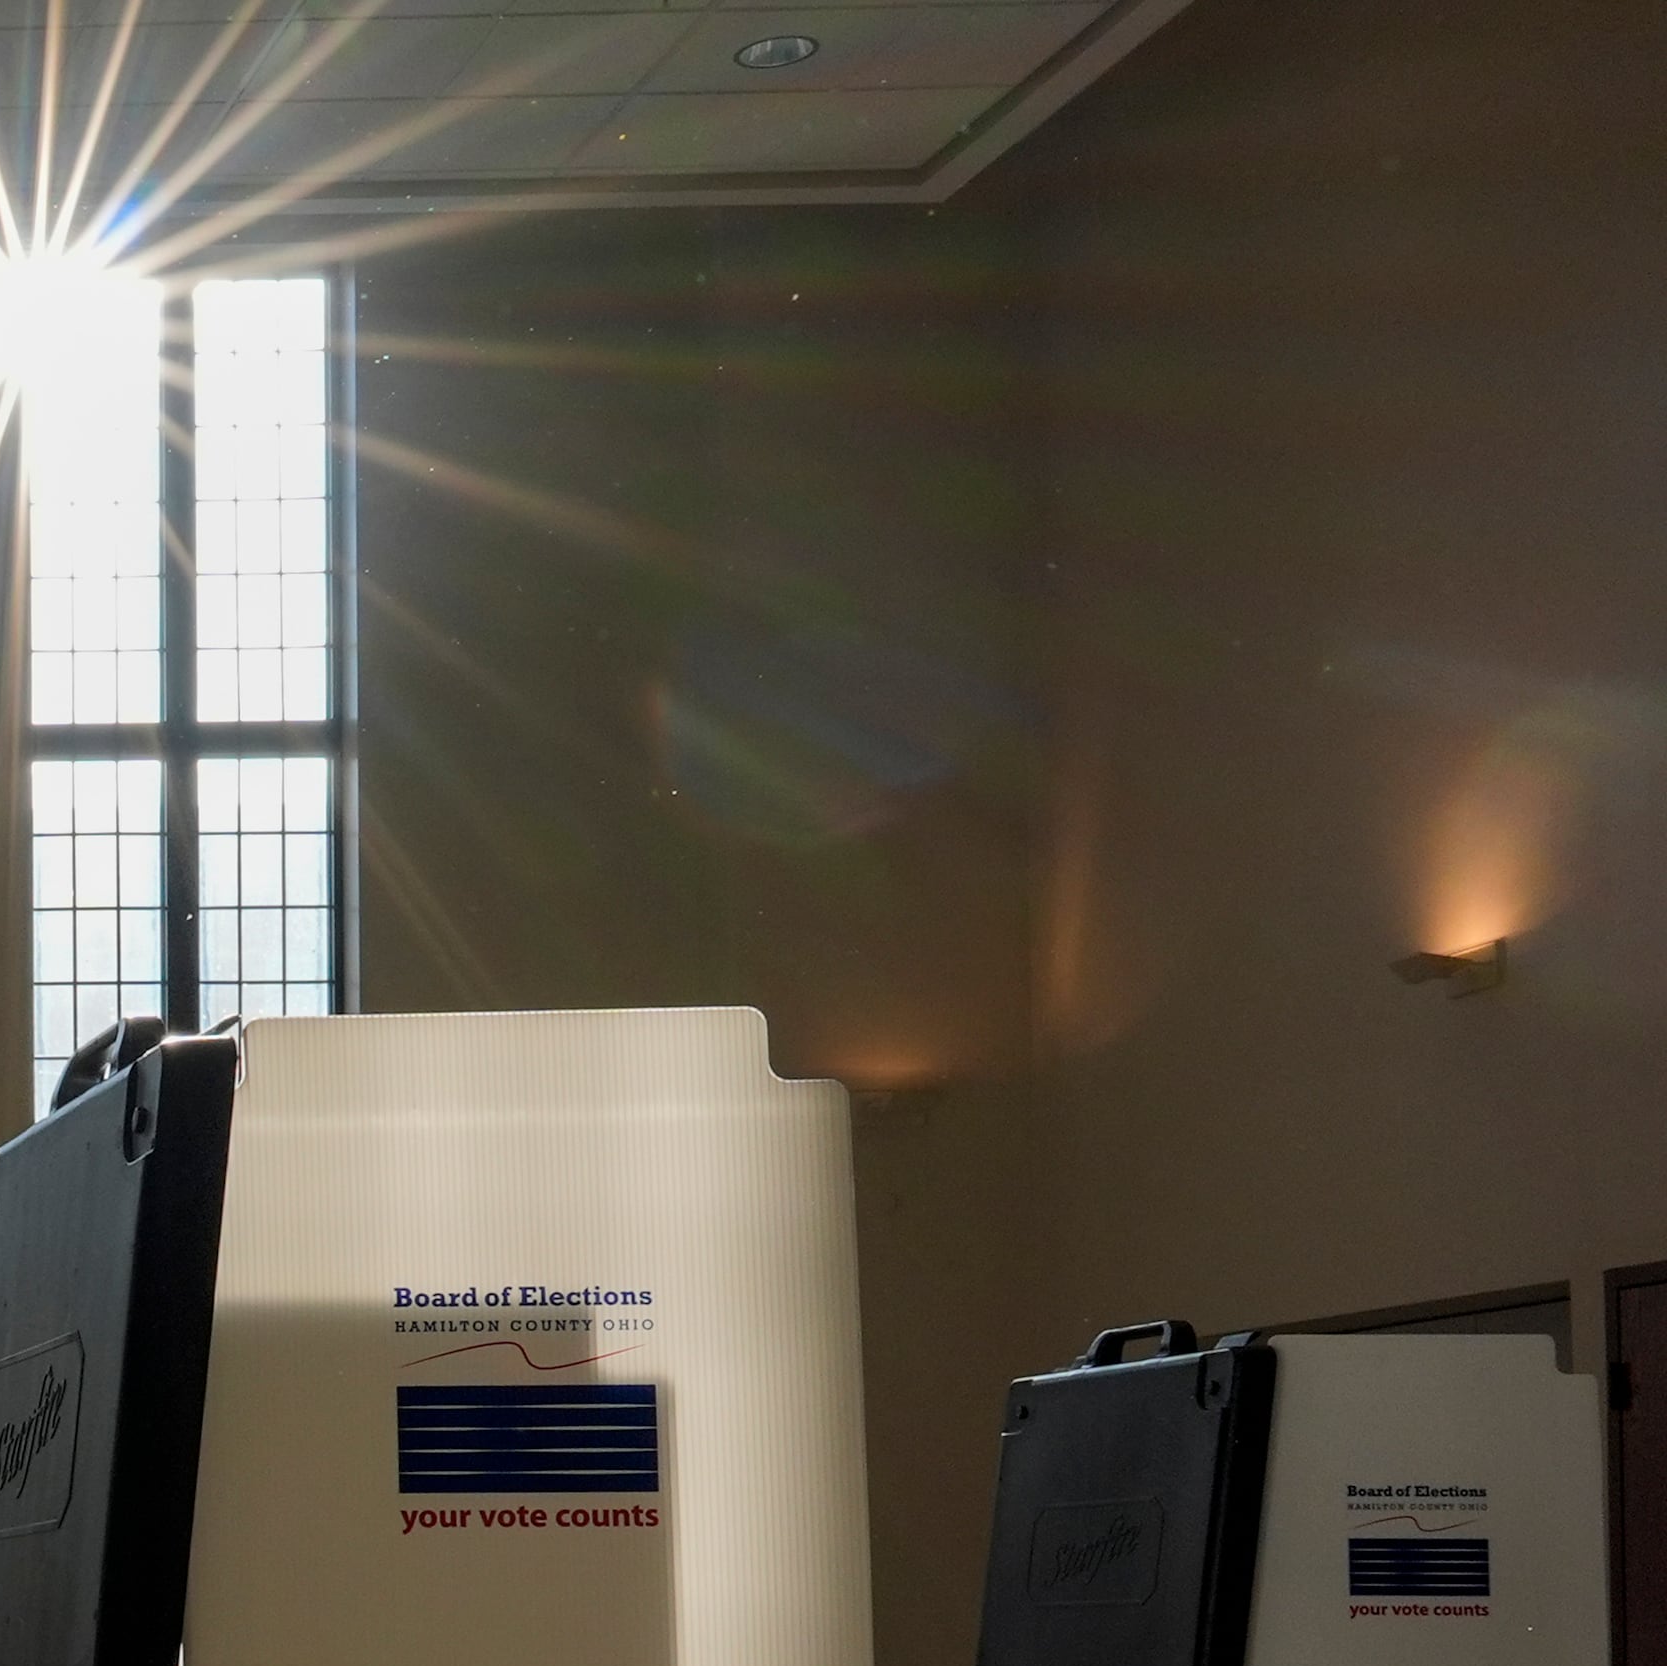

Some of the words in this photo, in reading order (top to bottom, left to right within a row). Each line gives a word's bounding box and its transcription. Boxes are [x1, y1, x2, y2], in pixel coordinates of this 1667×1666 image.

[394, 1287, 477, 1307] Board
[485, 1287, 512, 1307] of
[519, 1286, 652, 1306] Elections
[395, 1320, 500, 1332] HAMILTON
[510, 1320, 593, 1332] COUNTY
[603, 1319, 655, 1331] OHIO
[1347, 1485, 1393, 1497] Board
[1396, 1485, 1411, 1497] of
[1414, 1486, 1487, 1497] Elections
[400, 1509, 471, 1534] your
[479, 1506, 548, 1527] vote
[556, 1505, 659, 1527] counts
[1350, 1605, 1387, 1619] your
[1392, 1604, 1428, 1616] vote
[1434, 1605, 1489, 1616] counts
